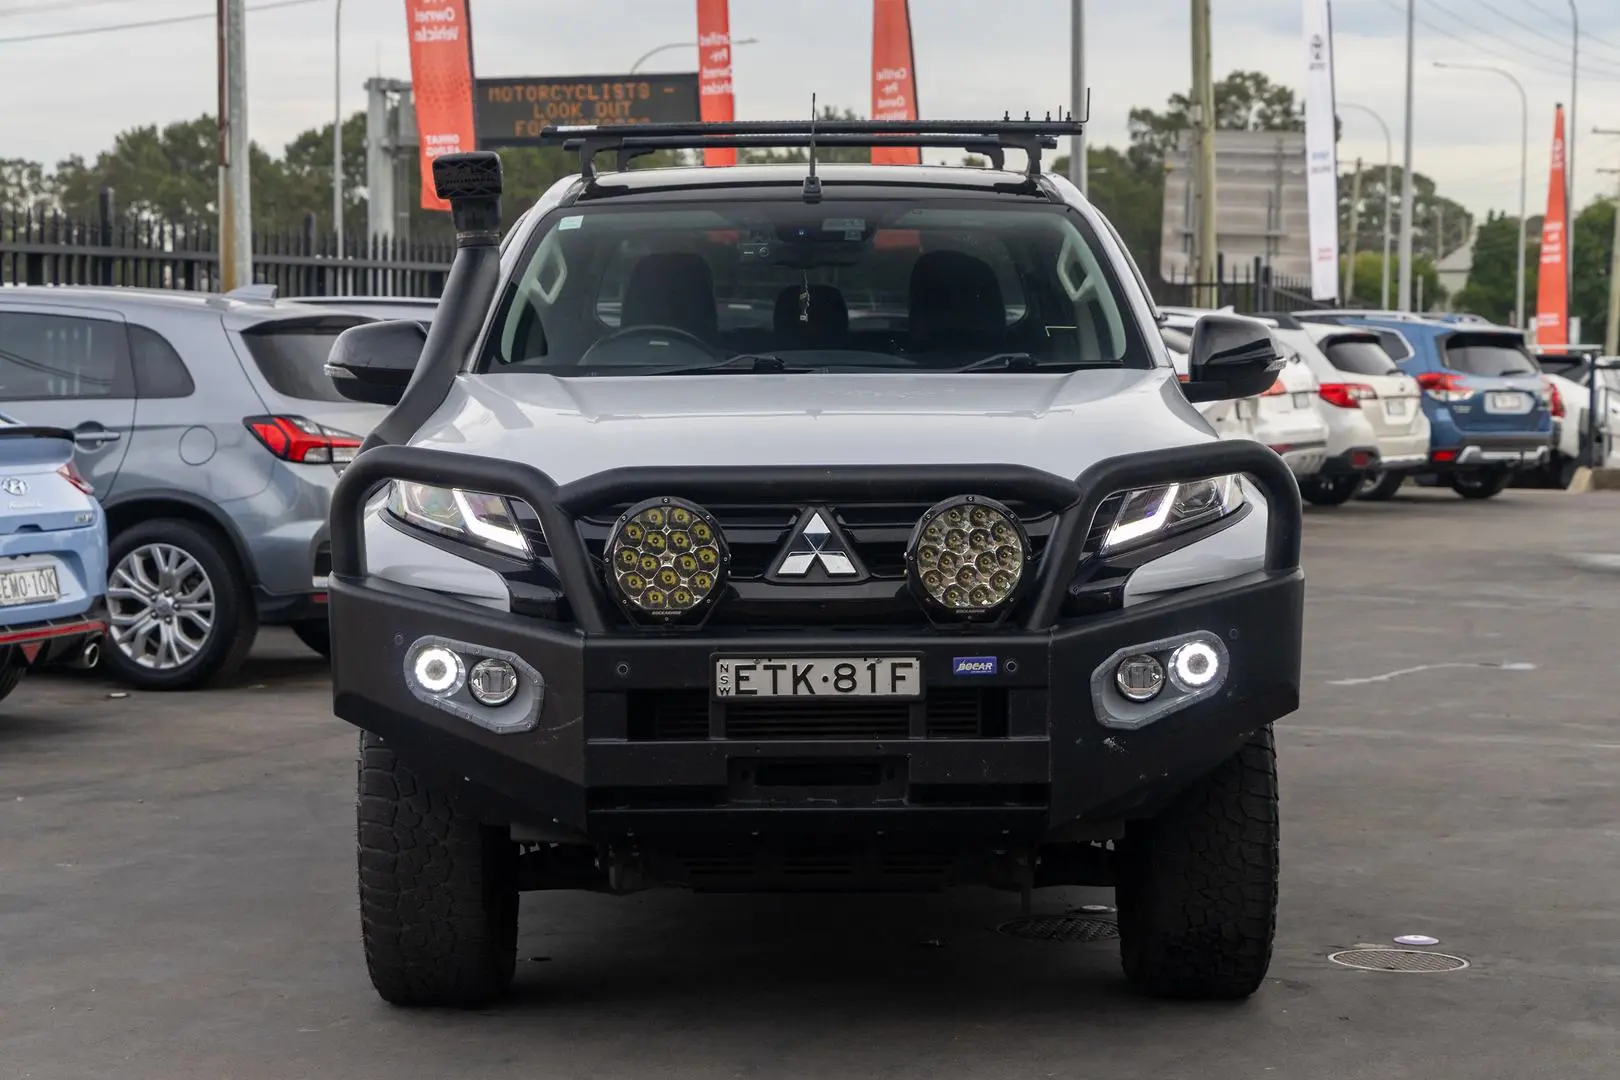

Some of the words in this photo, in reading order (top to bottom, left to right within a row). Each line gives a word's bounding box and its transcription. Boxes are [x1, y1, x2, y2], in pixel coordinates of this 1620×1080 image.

[488, 82, 651, 102] MOTORCYCLISTS
[533, 102, 582, 120] LOOK
[595, 101, 633, 119] OUT
[718, 662, 732, 695] NSW
